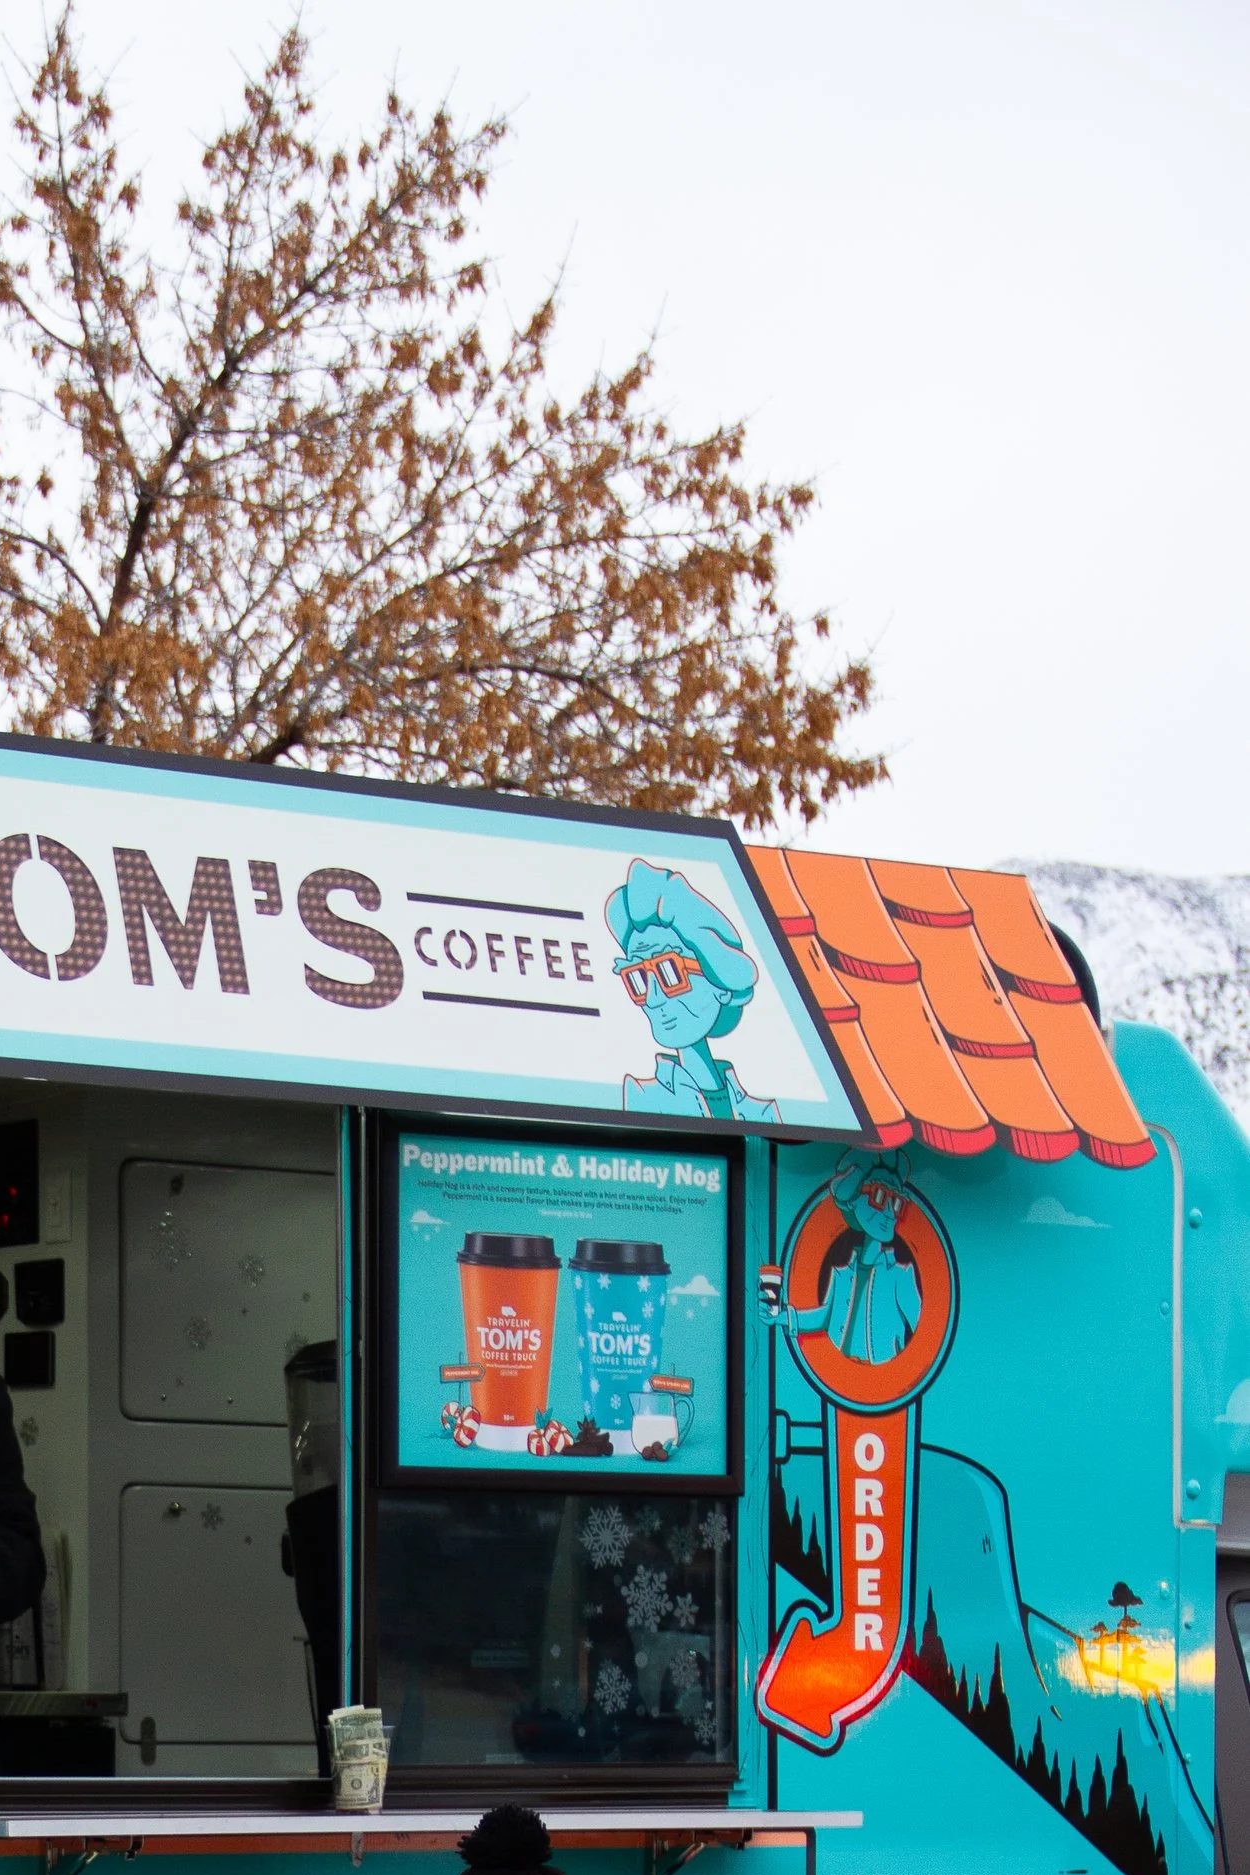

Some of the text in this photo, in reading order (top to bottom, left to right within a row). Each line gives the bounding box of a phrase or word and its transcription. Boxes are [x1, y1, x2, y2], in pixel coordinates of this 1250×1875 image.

[414, 925, 595, 985] COFFEE
[402, 1143, 721, 1193] Peppermint & Holiday Nog
[477, 1326, 542, 1351] TOM'S
[588, 1331, 651, 1356] TOM'S
[482, 1350, 537, 1361] COFFEE TRUCK
[592, 1356, 647, 1366] COFFEE TRUCK
[853, 1431, 886, 1652] ORDER
